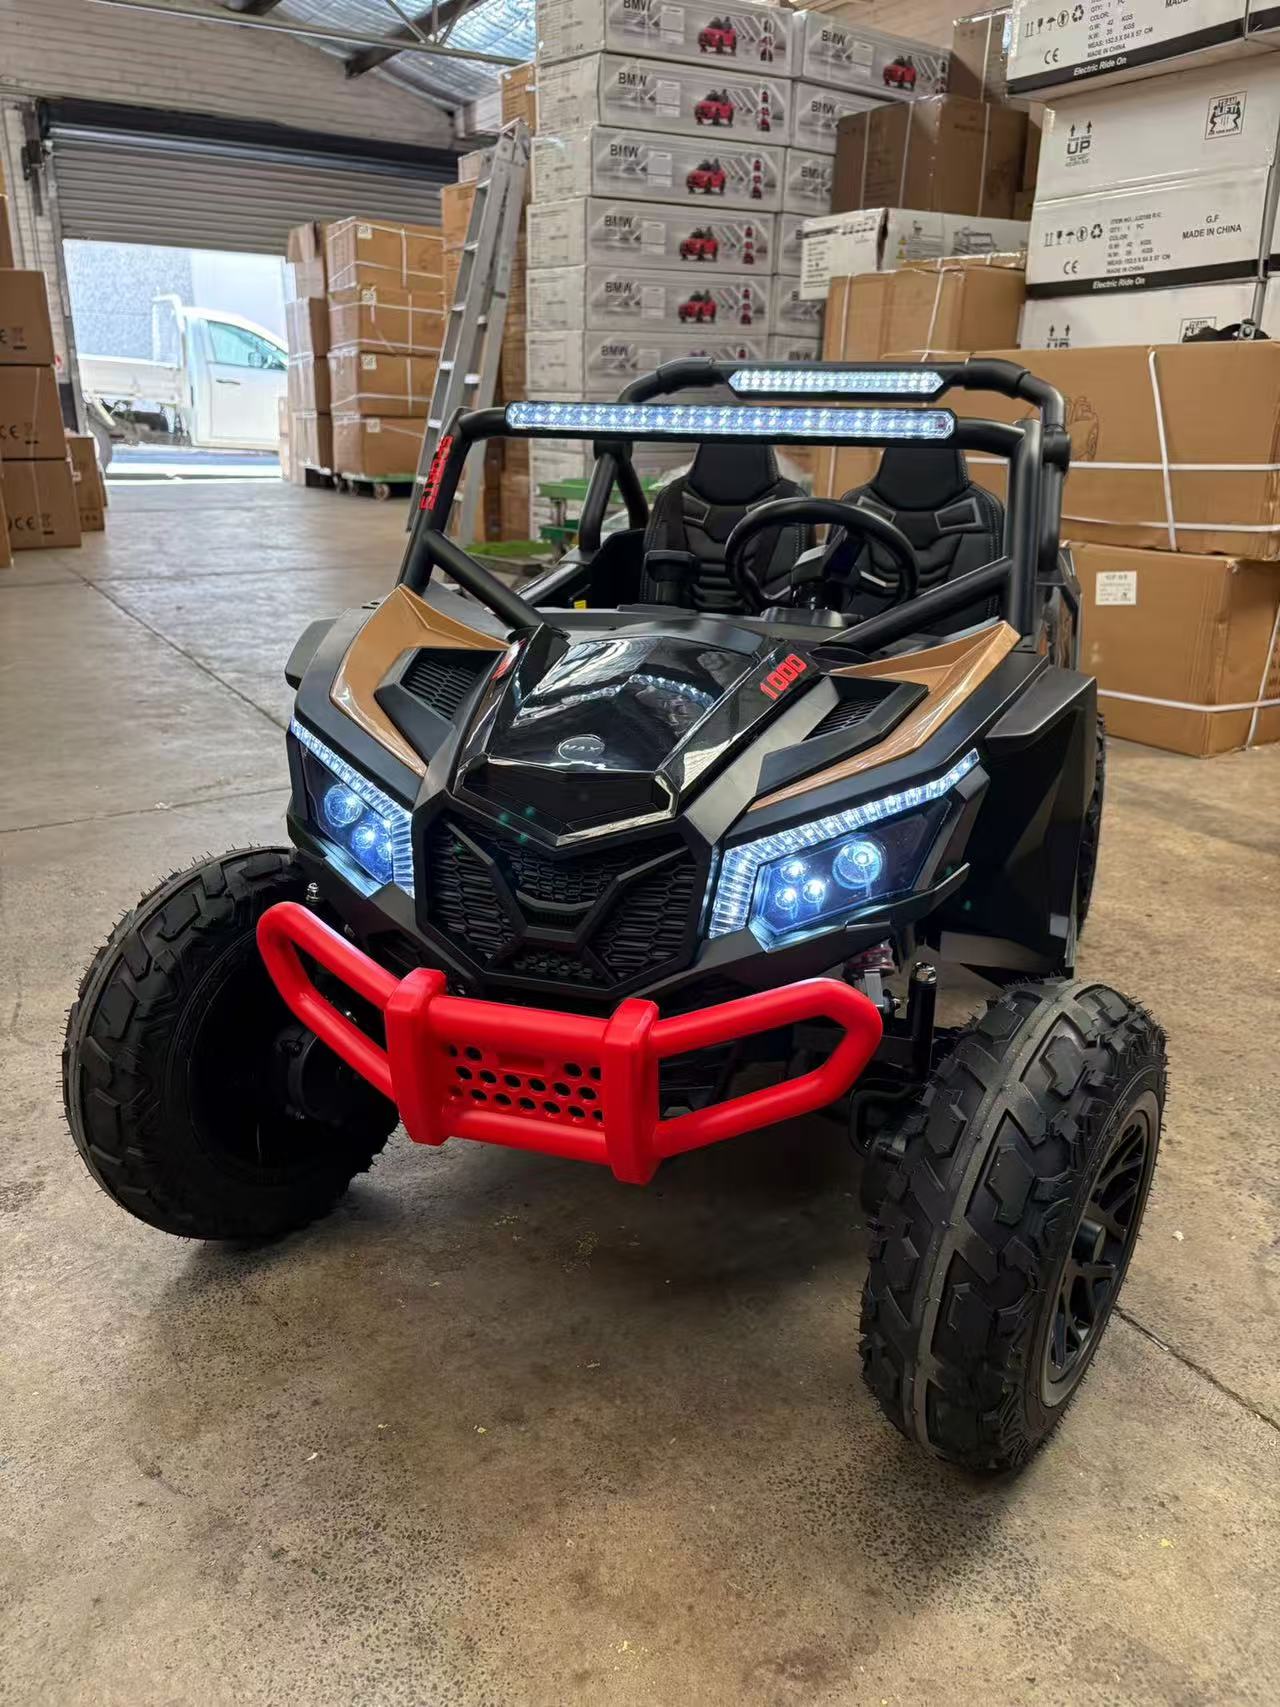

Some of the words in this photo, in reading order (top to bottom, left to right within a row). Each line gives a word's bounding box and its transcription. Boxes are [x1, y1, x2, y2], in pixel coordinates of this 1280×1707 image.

[822, 30, 846, 46] BMW
[1073, 62, 1099, 76] Electric
[1099, 59, 1115, 70] Ride
[1116, 56, 1127, 65] On
[618, 72, 647, 87] BMW
[811, 100, 836, 115] BMW
[610, 144, 639, 158] BMW
[1067, 140, 1091, 155] UP
[604, 215, 632, 229] BMW
[1182, 229, 1206, 240] MADE
[1206, 228, 1215, 237] IN
[1216, 223, 1242, 235] CHINA
[1092, 279, 1118, 289] Electric
[1118, 278, 1134, 287] Ride
[1134, 277, 1145, 285] On
[760, 653, 808, 701] 1000
